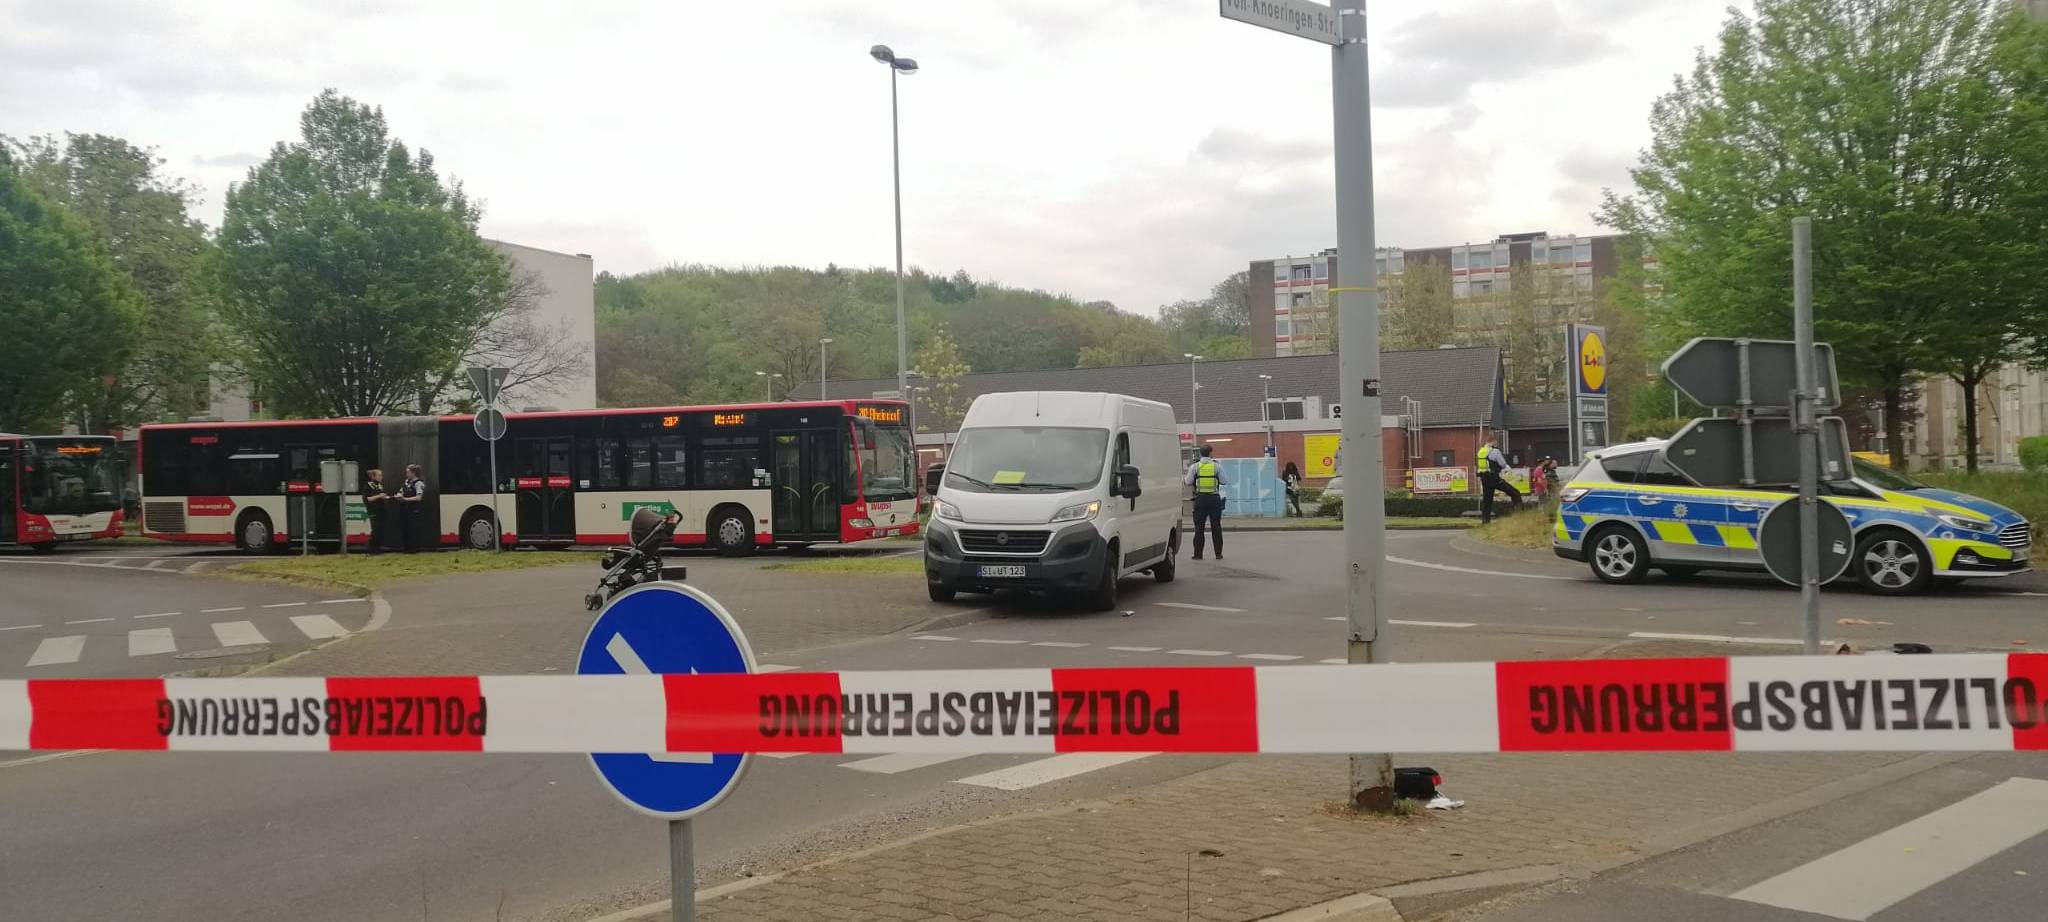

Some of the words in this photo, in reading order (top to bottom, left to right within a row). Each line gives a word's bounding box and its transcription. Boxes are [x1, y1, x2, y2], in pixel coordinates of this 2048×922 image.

[1010, 567, 1024, 575] 123
[157, 695, 487, 737] POLIZEIABSPERRUNG
[759, 689, 1180, 738] POLIZEIABSPERRUNG
[1529, 677, 2048, 734] OLIZEIABSPERRUNG
